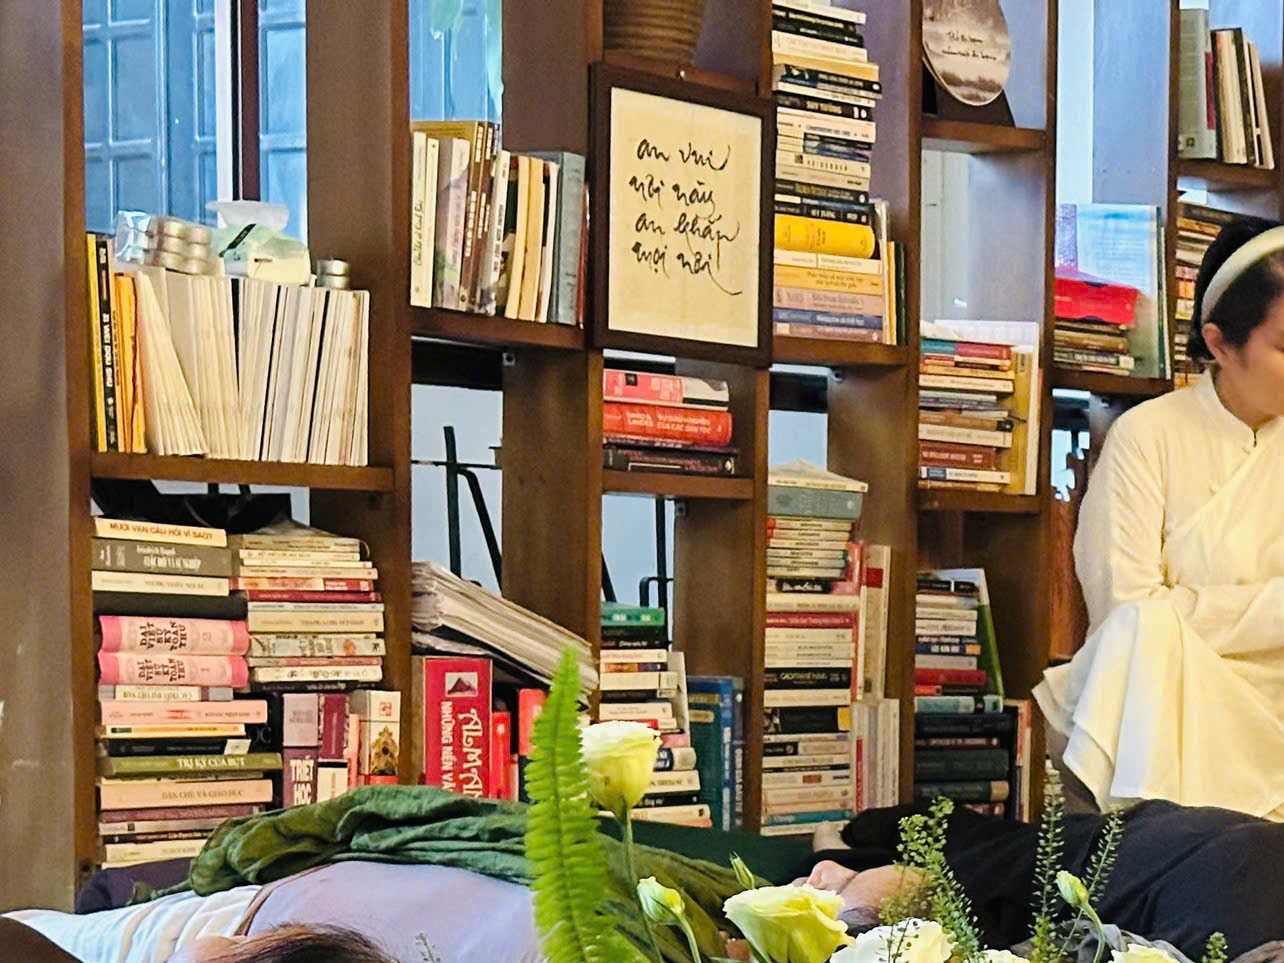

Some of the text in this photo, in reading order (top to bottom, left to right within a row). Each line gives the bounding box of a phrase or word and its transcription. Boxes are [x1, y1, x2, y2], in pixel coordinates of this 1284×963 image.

[637, 138, 731, 171] an vui
[635, 213, 665, 235] an
